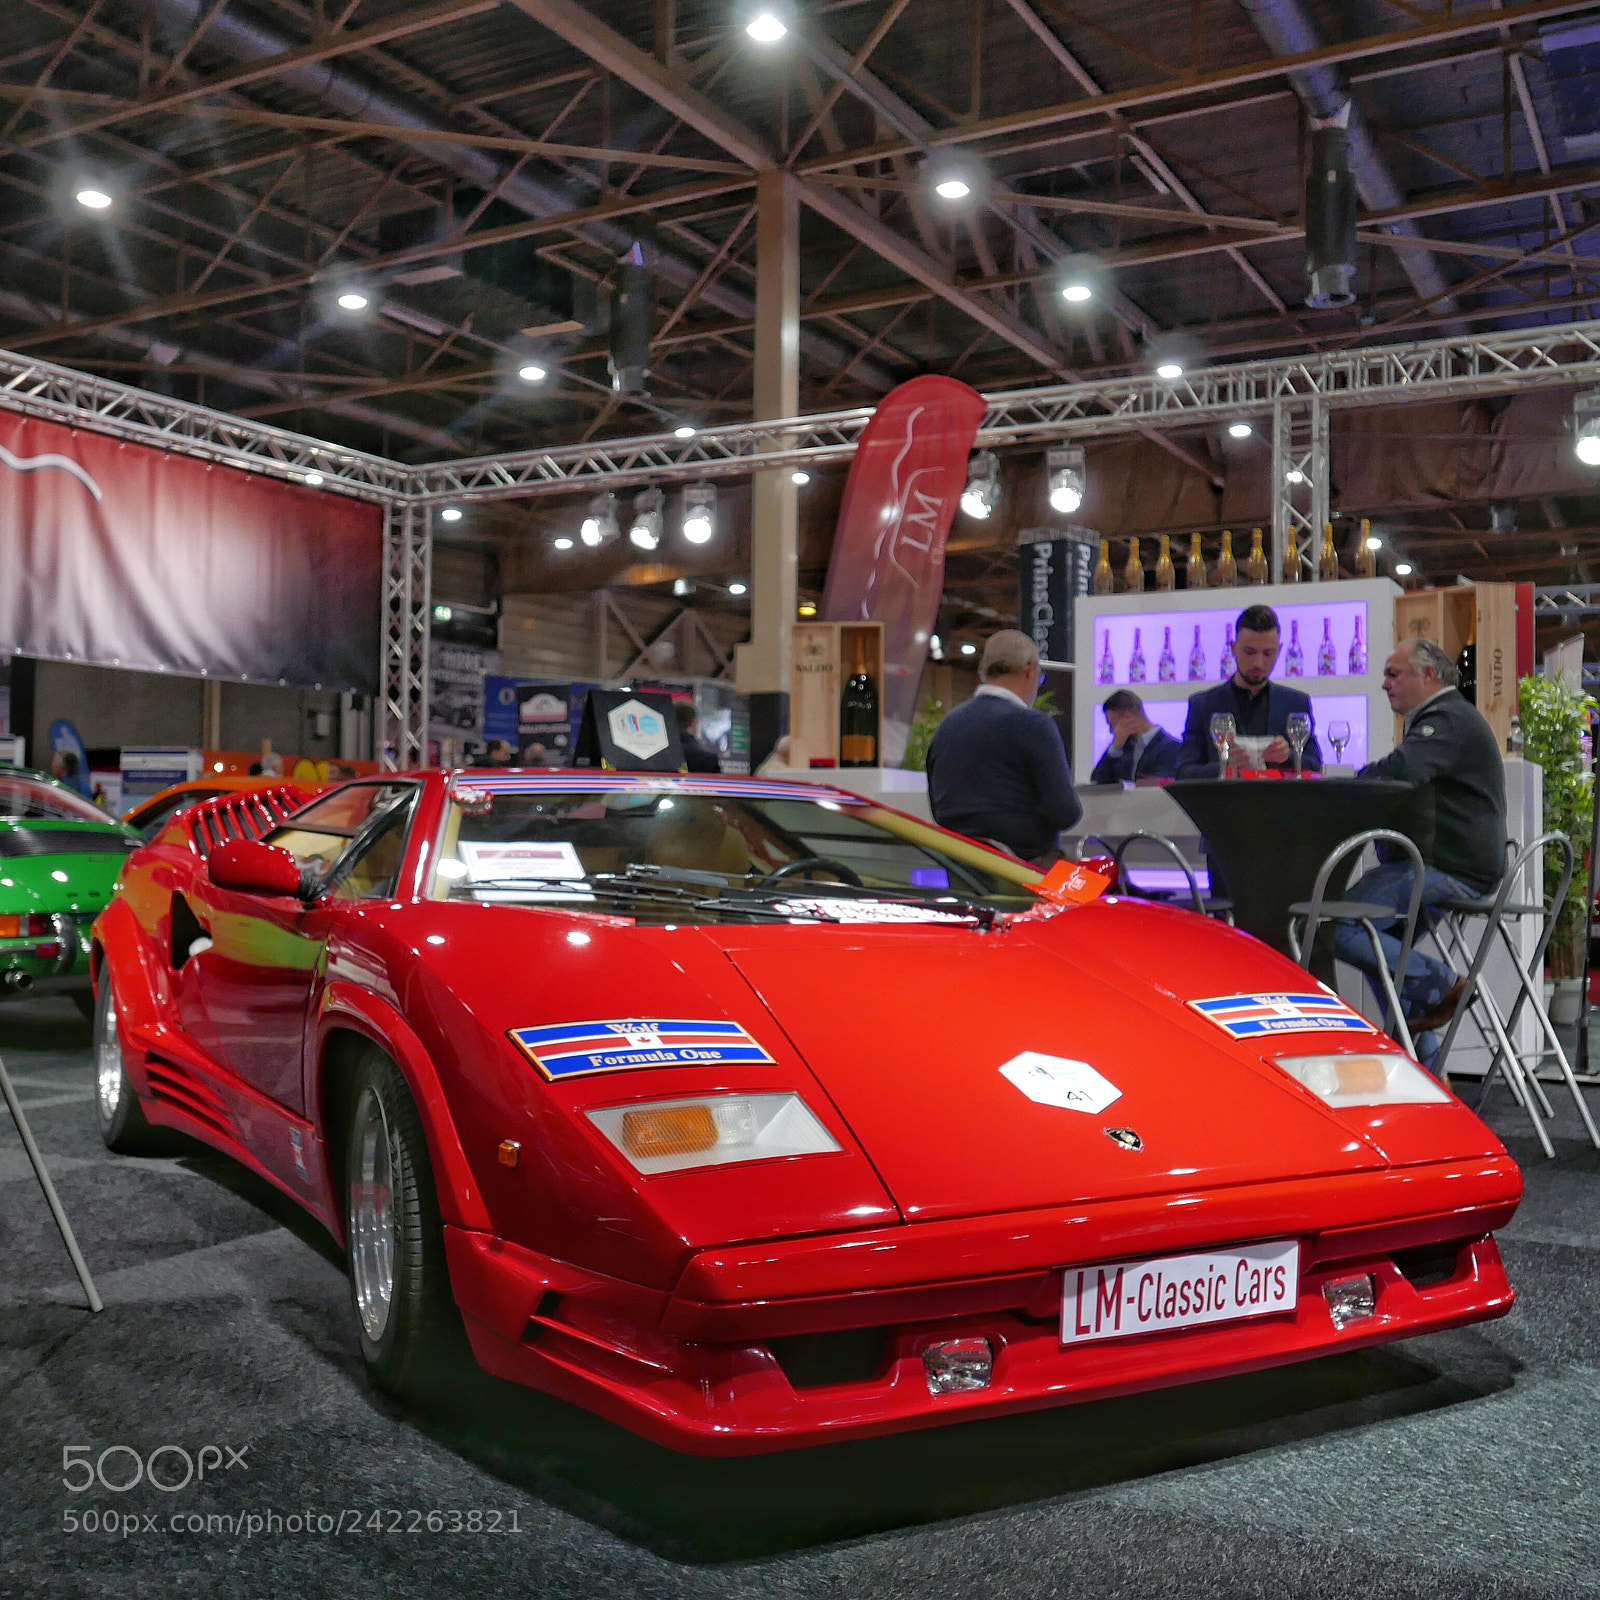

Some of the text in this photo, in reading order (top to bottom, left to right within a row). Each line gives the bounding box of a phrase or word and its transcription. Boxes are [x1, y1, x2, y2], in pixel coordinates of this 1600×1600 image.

[901, 489, 943, 552] LM
[604, 1022, 660, 1034] Wolf
[1258, 1018, 1320, 1030] Formula
[588, 1049, 722, 1067] Formula One
[1075, 1258, 1286, 1336] LM-Classic Cars
